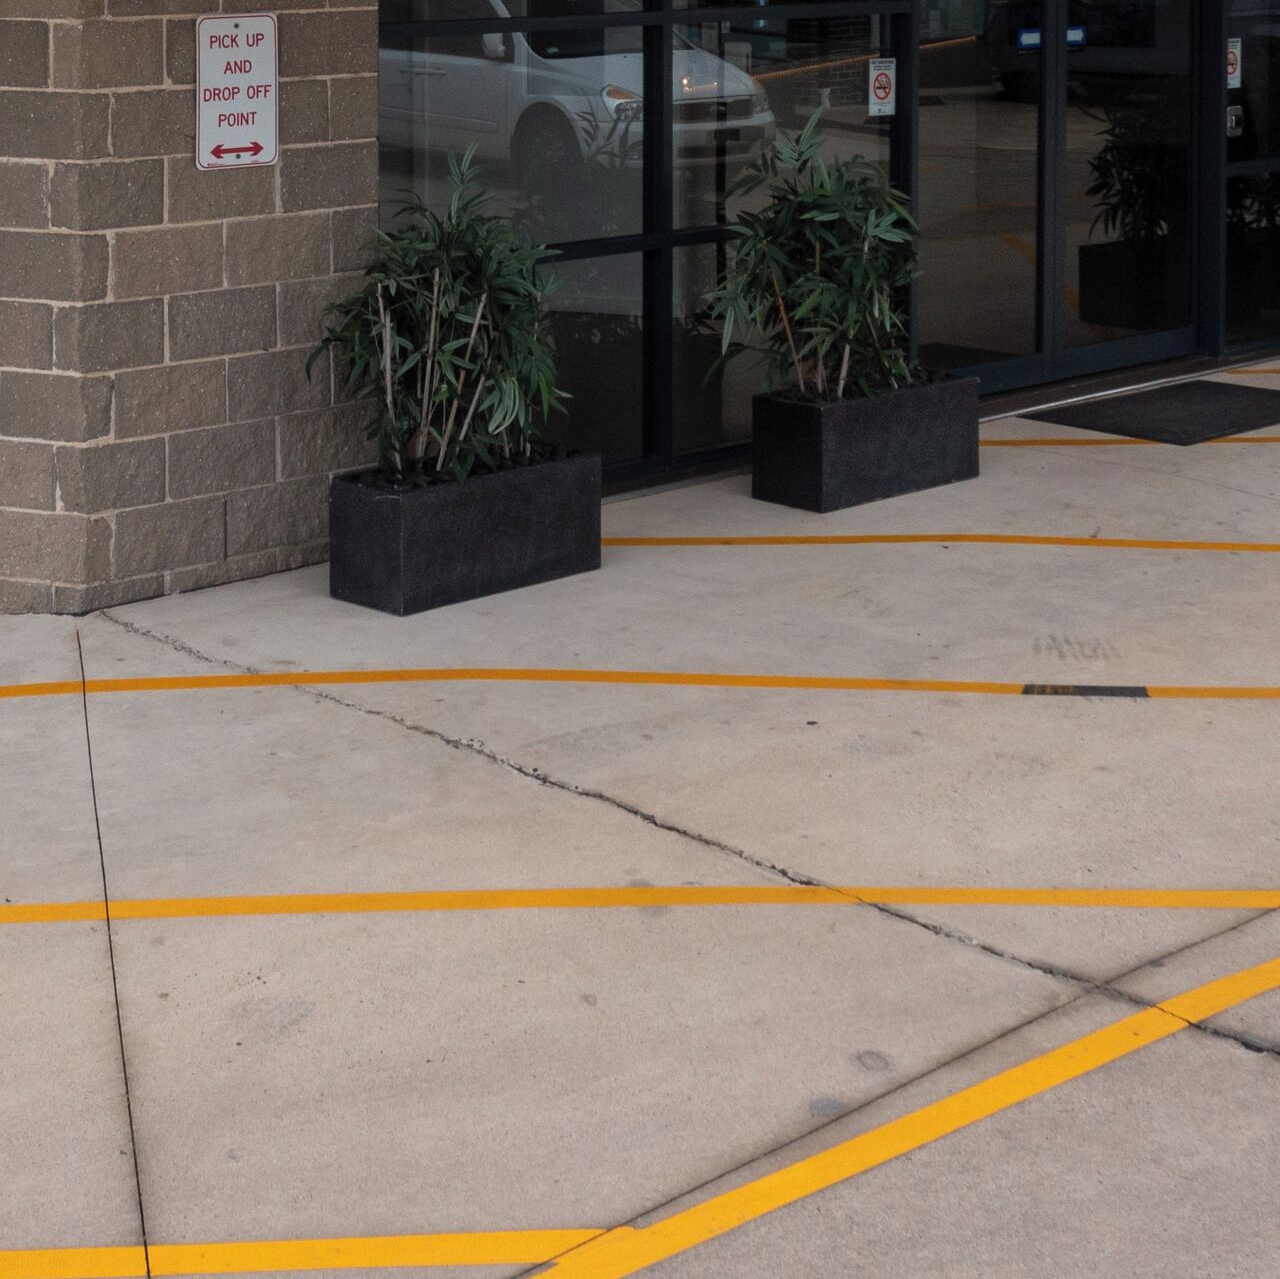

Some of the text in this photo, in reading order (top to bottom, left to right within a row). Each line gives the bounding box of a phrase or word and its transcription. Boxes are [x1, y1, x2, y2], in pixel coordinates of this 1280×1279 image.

[209, 33, 265, 49] PICK UP
[223, 60, 252, 75] AND
[203, 85, 272, 103] DROP OFF
[218, 112, 258, 128] POINT
